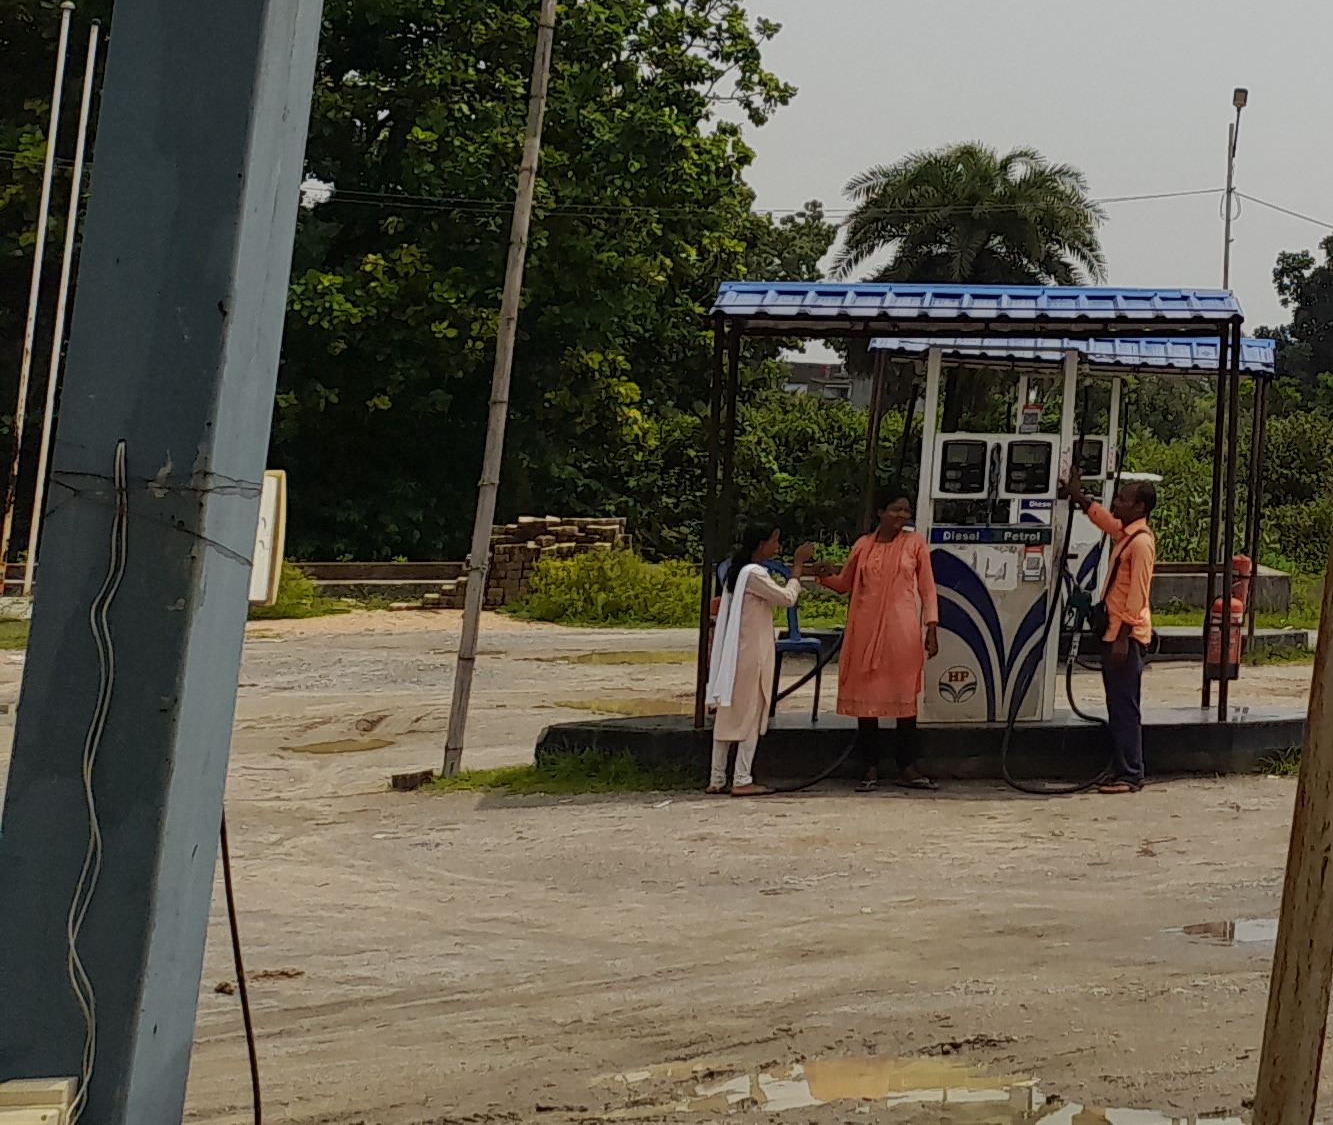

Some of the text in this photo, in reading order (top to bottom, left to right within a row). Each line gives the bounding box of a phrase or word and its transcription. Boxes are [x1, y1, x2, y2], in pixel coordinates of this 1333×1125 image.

[943, 531, 980, 541] Diesel
[1004, 531, 1040, 541] Petrol
[948, 671, 969, 682] HP
